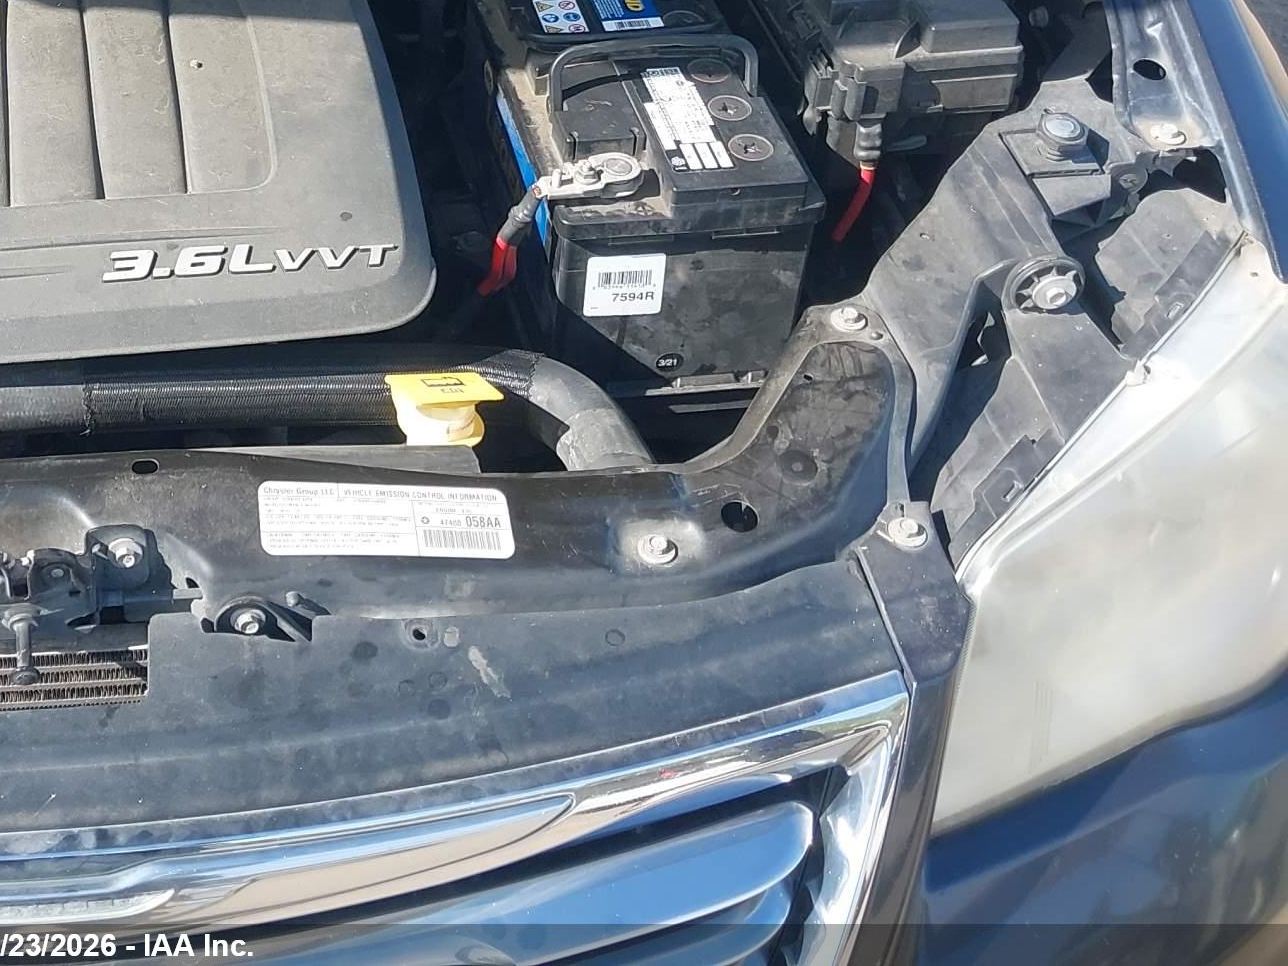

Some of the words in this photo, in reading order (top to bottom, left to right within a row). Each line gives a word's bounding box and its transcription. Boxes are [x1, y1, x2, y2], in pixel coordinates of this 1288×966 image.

[611, 291, 655, 302] 7594R
[658, 357, 678, 367] 3/21
[263, 487, 294, 496] Chrysler
[296, 487, 319, 496] Group
[344, 489, 372, 497] VEHICLE
[375, 490, 411, 498] EMISSION
[412, 491, 445, 499] CONTROL
[447, 493, 497, 502] INFORMATION
[465, 515, 502, 528] 058AA
